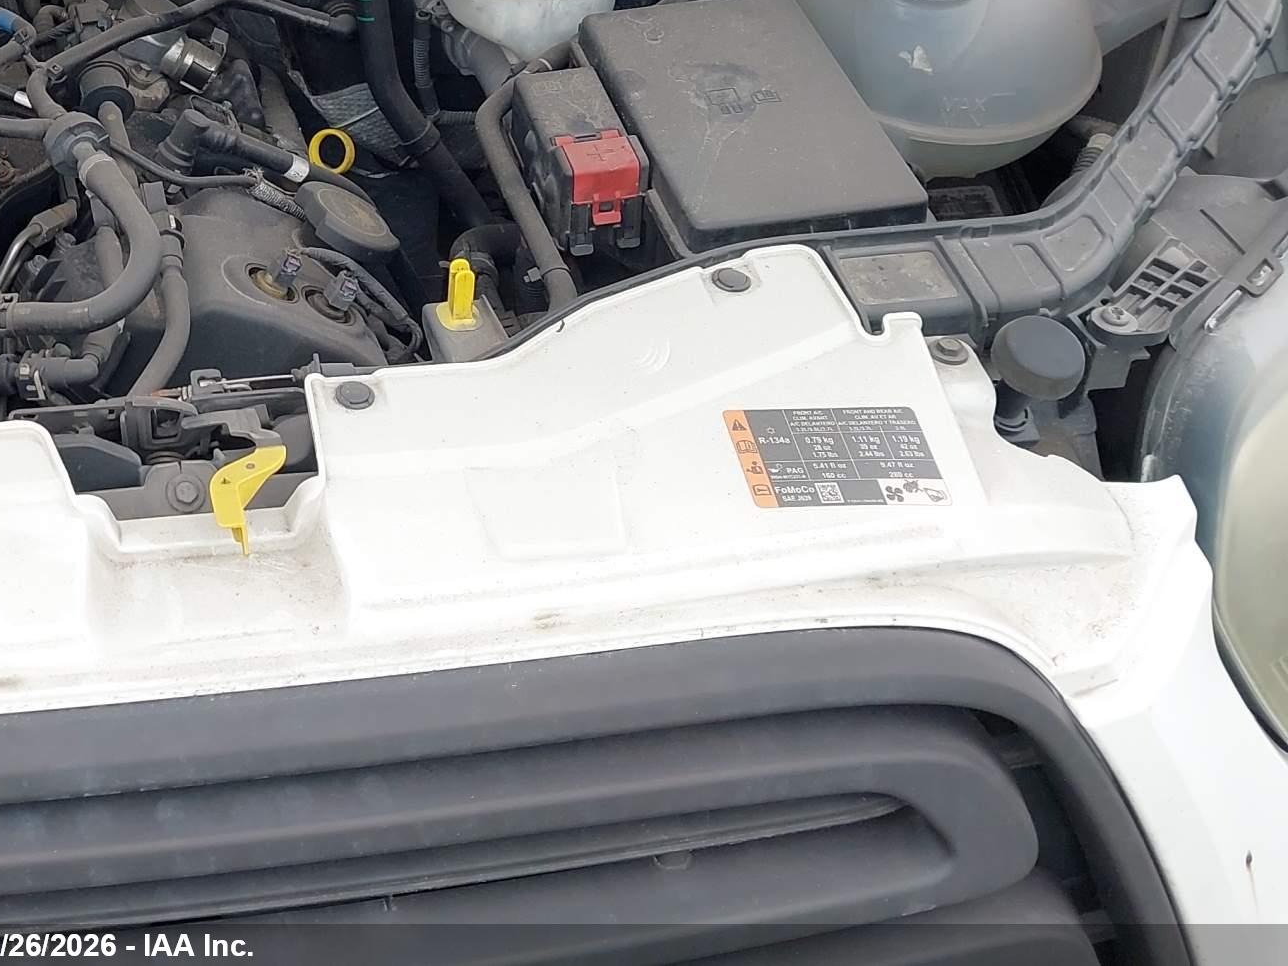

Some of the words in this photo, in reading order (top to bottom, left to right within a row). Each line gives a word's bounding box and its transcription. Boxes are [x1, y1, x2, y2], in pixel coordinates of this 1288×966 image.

[758, 436, 790, 444] R-134a
[822, 436, 834, 445] kg
[869, 436, 880, 445] kg
[908, 435, 920, 444] kg
[774, 486, 815, 495] FoMoCo
